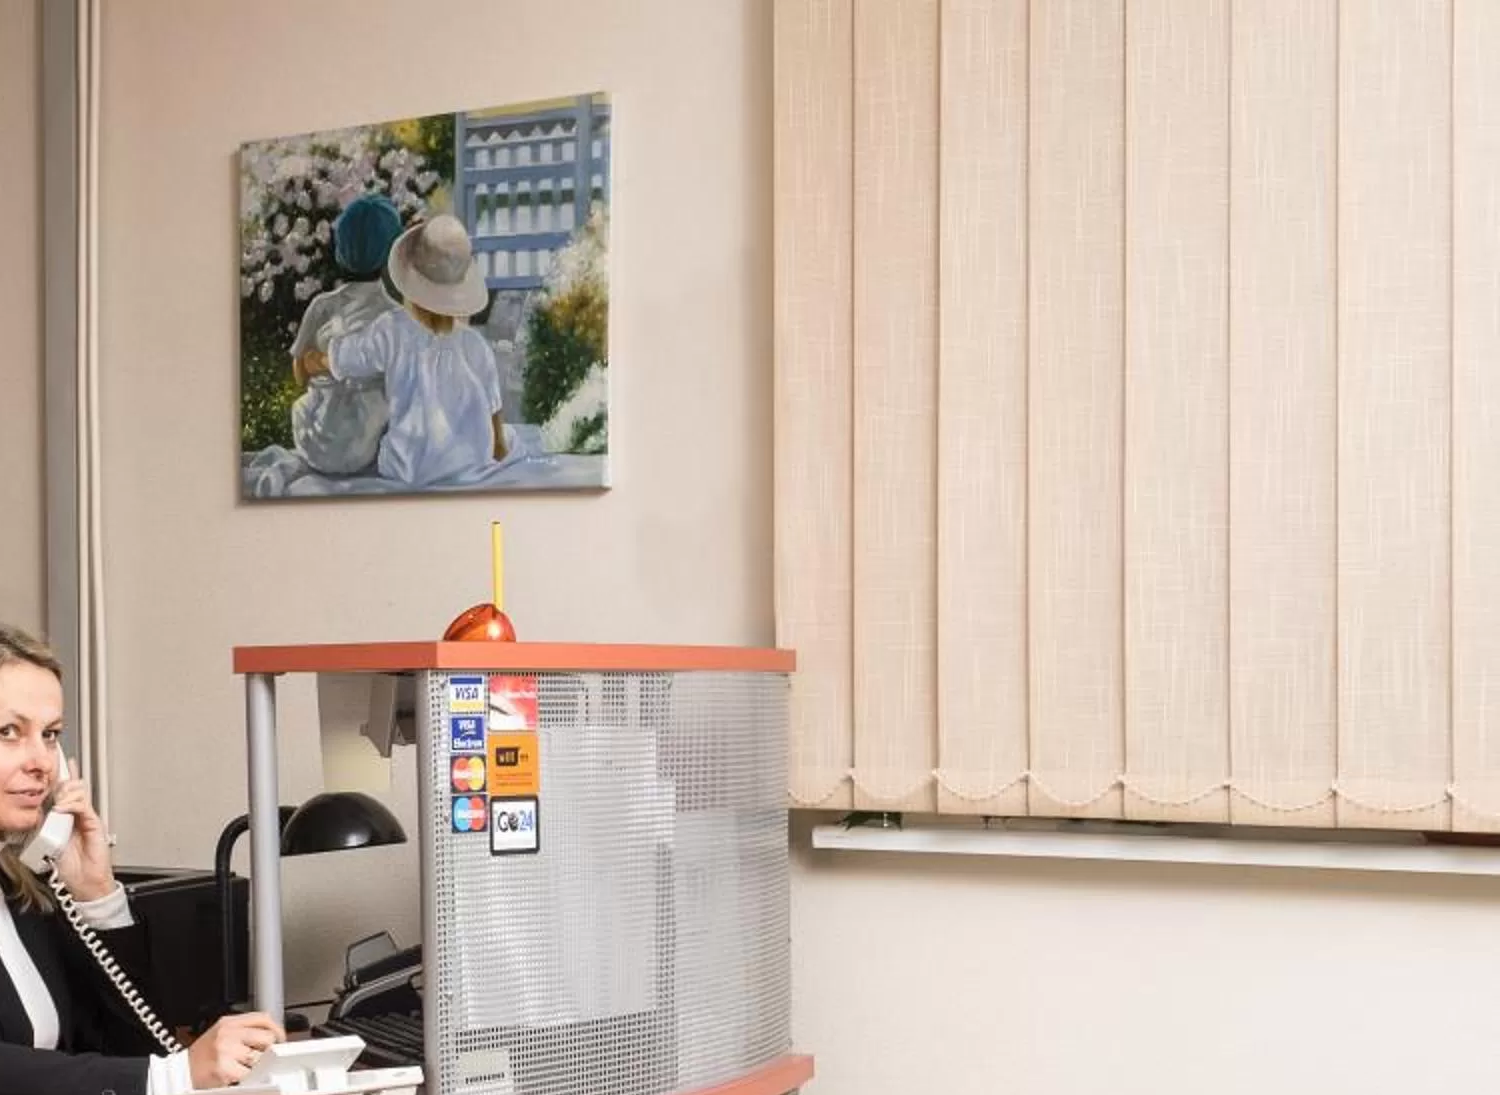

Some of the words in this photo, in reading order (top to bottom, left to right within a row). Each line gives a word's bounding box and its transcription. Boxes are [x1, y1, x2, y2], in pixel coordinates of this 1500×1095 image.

[455, 687, 479, 700] VISA
[458, 720, 476, 732] VISA
[453, 738, 483, 749] Electron
